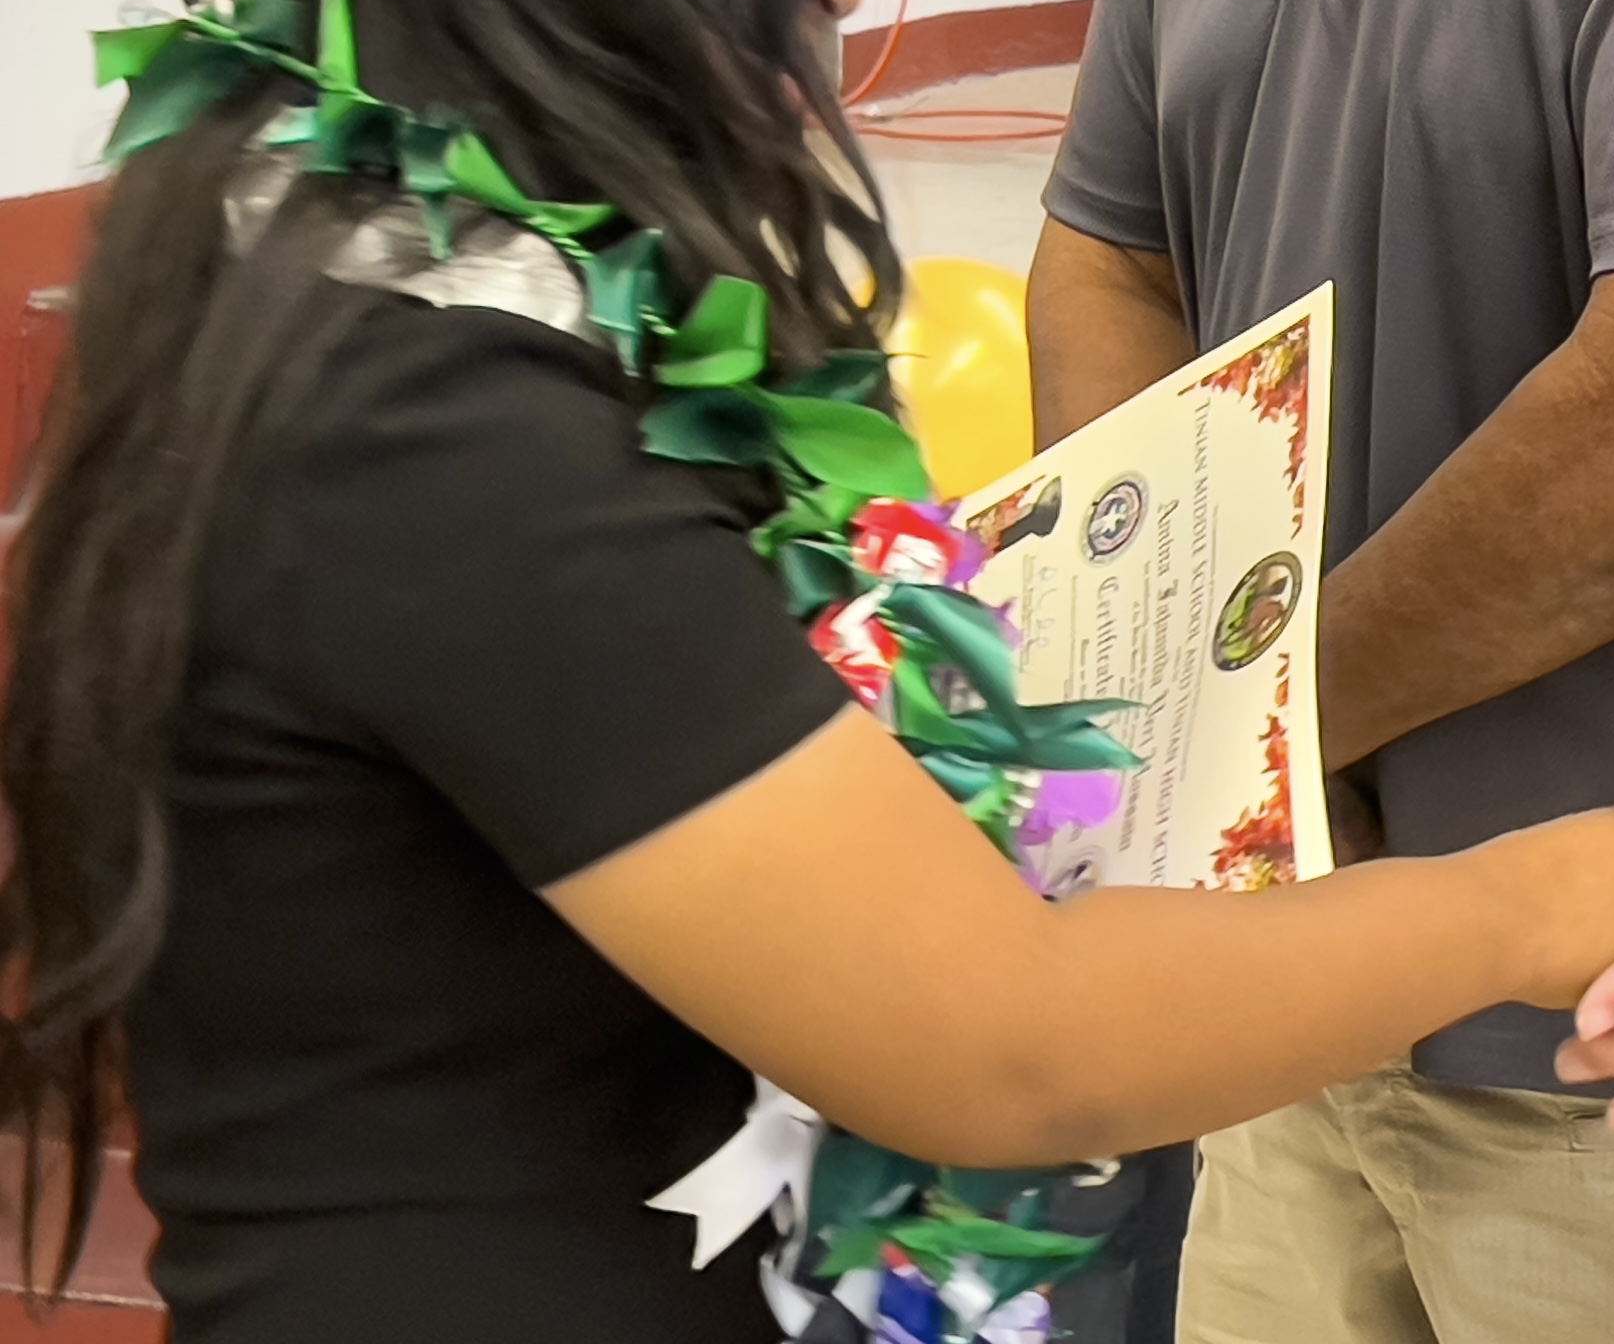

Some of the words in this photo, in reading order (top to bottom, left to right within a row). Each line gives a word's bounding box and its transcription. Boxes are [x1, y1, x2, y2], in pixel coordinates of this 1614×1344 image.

[1194, 397, 1210, 474] TINIAN
[1191, 475, 1208, 557] MIDDLE
[1186, 558, 1207, 643] SCHOOL
[1178, 645, 1197, 693] AND
[1155, 765, 1176, 828] HIGH
[1149, 828, 1168, 887] SCHO
